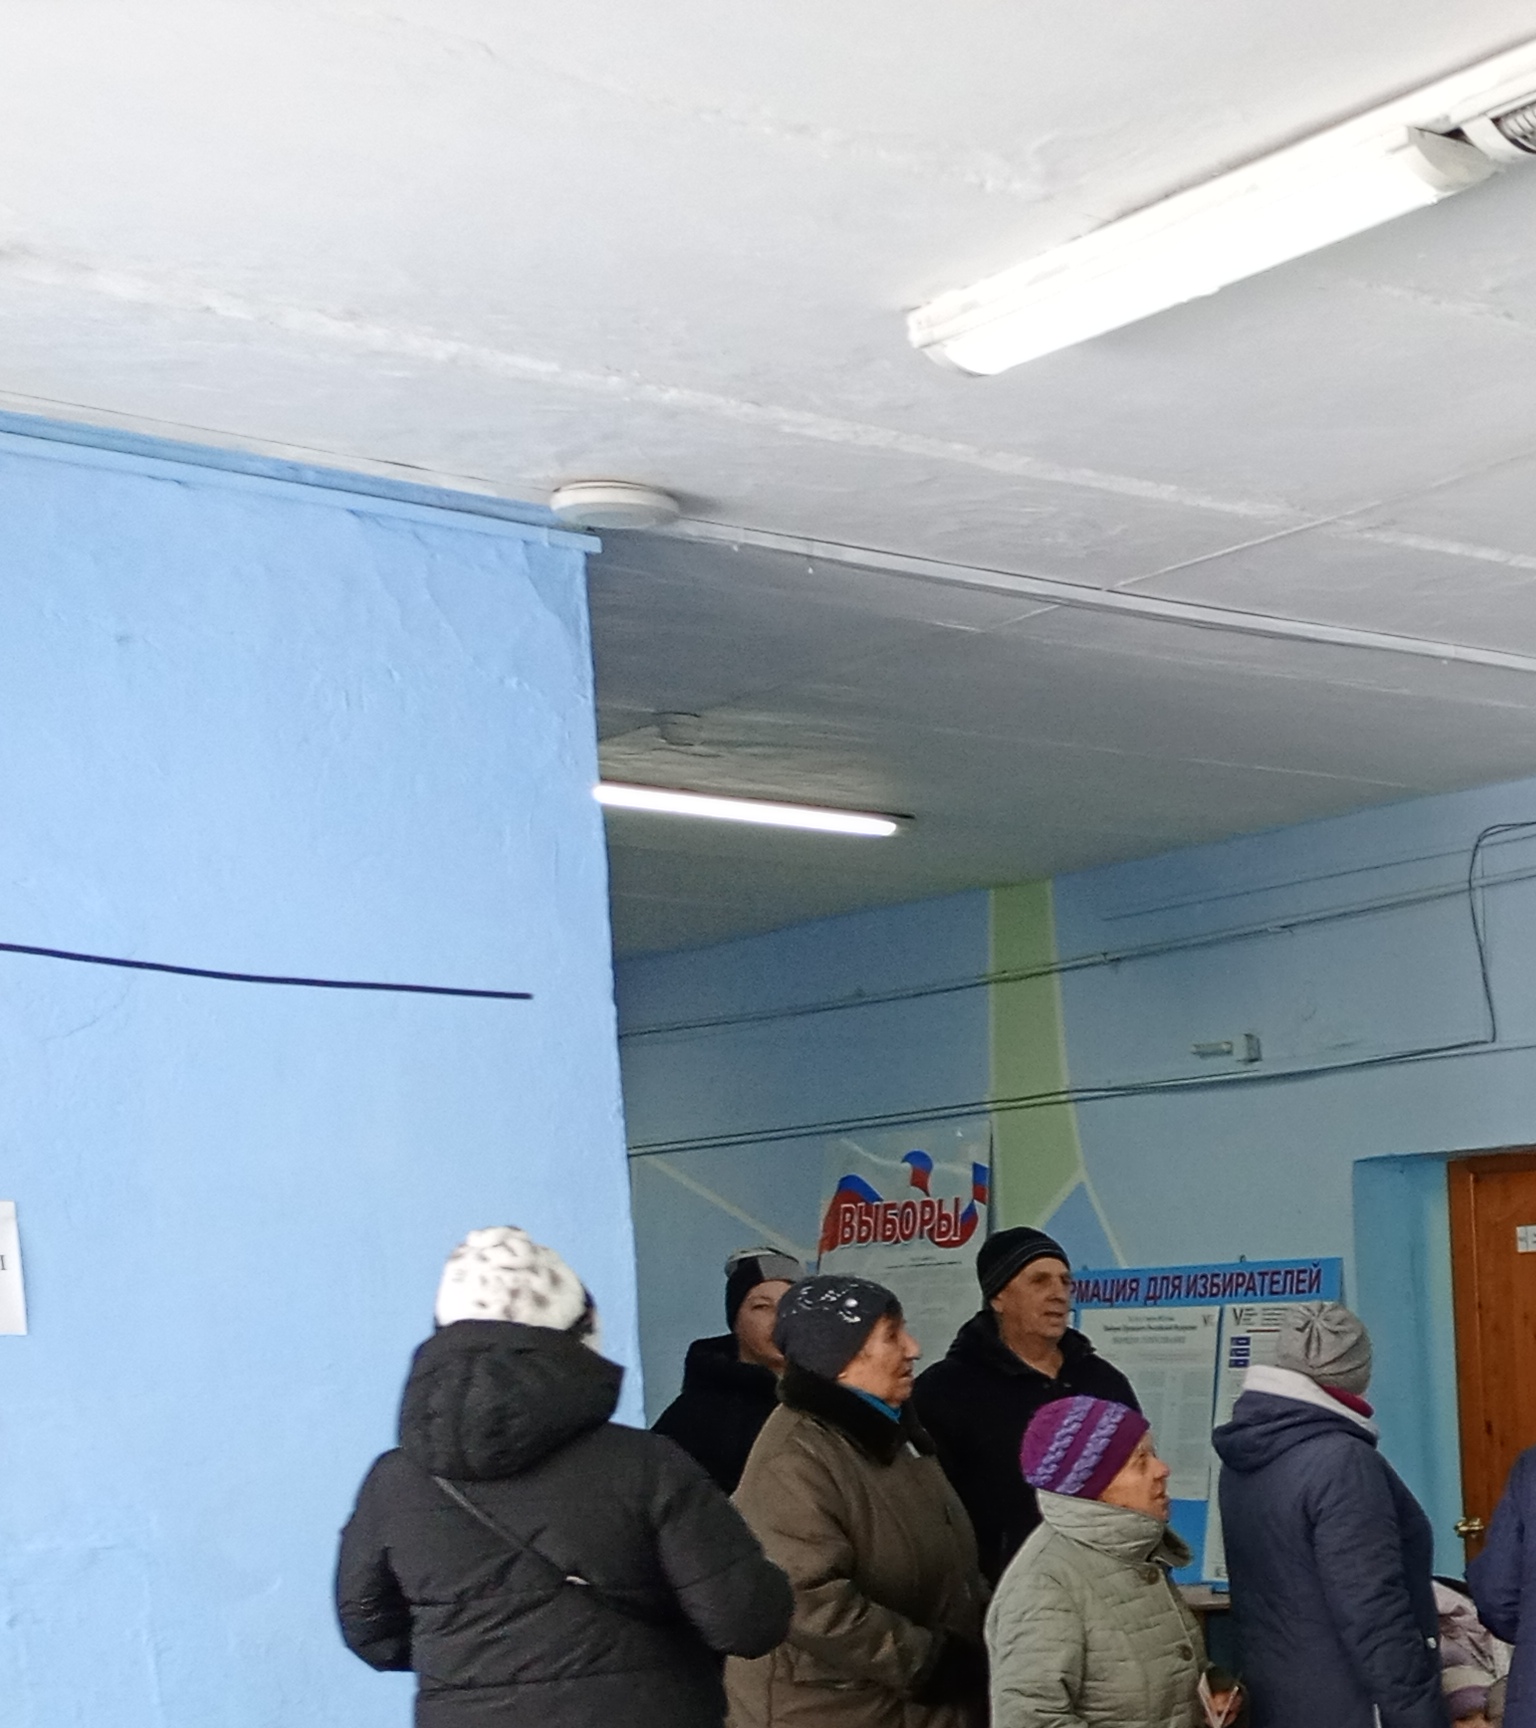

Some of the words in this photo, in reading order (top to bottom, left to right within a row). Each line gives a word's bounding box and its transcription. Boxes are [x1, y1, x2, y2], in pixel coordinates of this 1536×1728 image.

[839, 1197, 961, 1248] ВЫБОРЫ
[1070, 1277, 1140, 1308] РМАЦИЯ
[1143, 1275, 1183, 1306] ДЛЯ
[1185, 1262, 1322, 1299] ИЗБИРАТЕЛЕЙ
